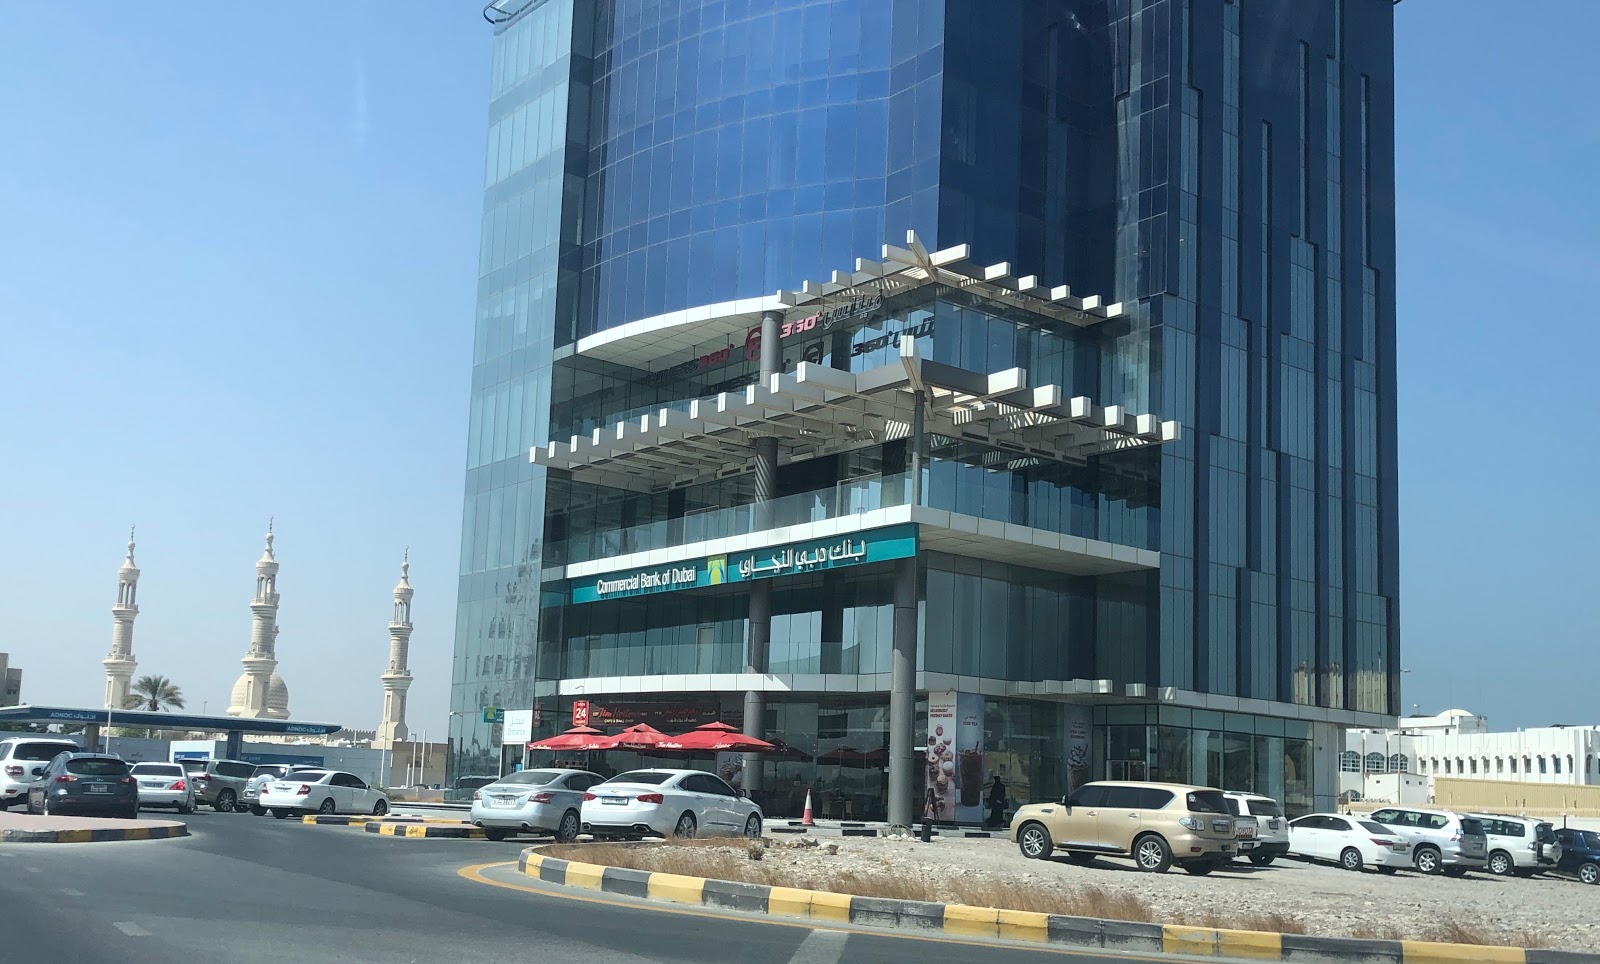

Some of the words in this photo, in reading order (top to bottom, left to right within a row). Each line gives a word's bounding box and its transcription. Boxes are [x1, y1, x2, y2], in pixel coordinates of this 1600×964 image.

[780, 310, 822, 338] 360°
[795, 547, 828, 570] دبي
[829, 539, 867, 562] بنك
[739, 548, 794, 578] التجاري
[596, 573, 640, 595] Commercial
[640, 571, 662, 588] Bank
[661, 569, 671, 585] of
[672, 565, 697, 584] Dubai
[50, 711, 73, 719] ADNOC
[575, 707, 587, 719] 24
